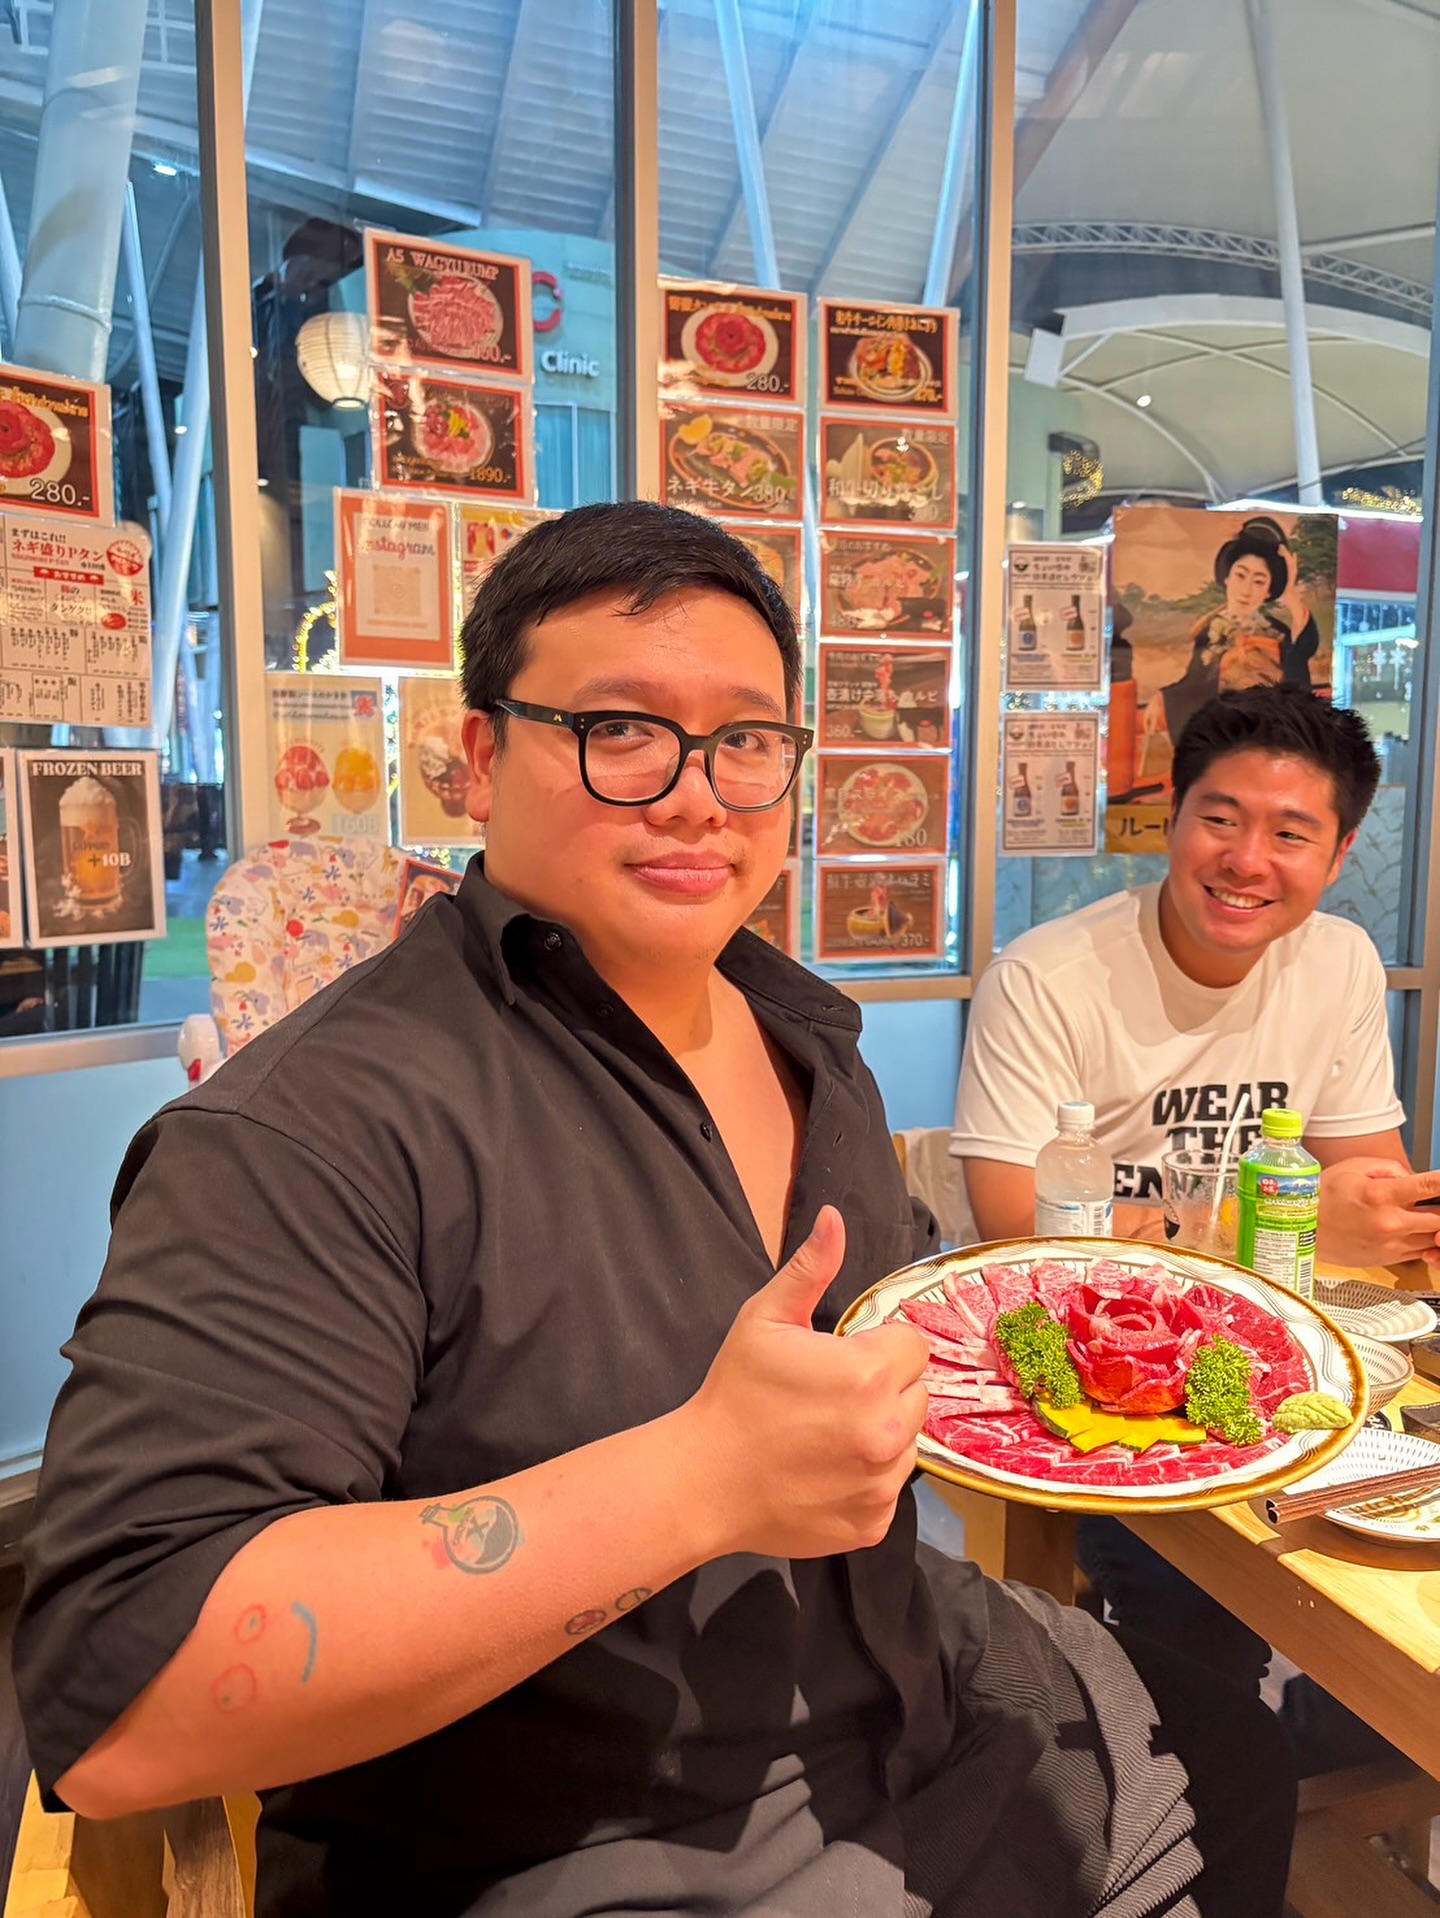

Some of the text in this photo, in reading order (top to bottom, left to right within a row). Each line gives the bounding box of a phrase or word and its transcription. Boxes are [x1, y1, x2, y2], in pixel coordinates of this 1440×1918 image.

[386, 248, 404, 263] A5
[410, 252, 461, 273] WAGYU
[541, 350, 600, 377] Clinic
[746, 373, 790, 393] 280.-
[30, 478, 91, 507] 280.-
[366, 536, 436, 561] nstagram
[32, 762, 142, 776] FROZEN BEER
[1152, 1081, 1289, 1126] WEAR
